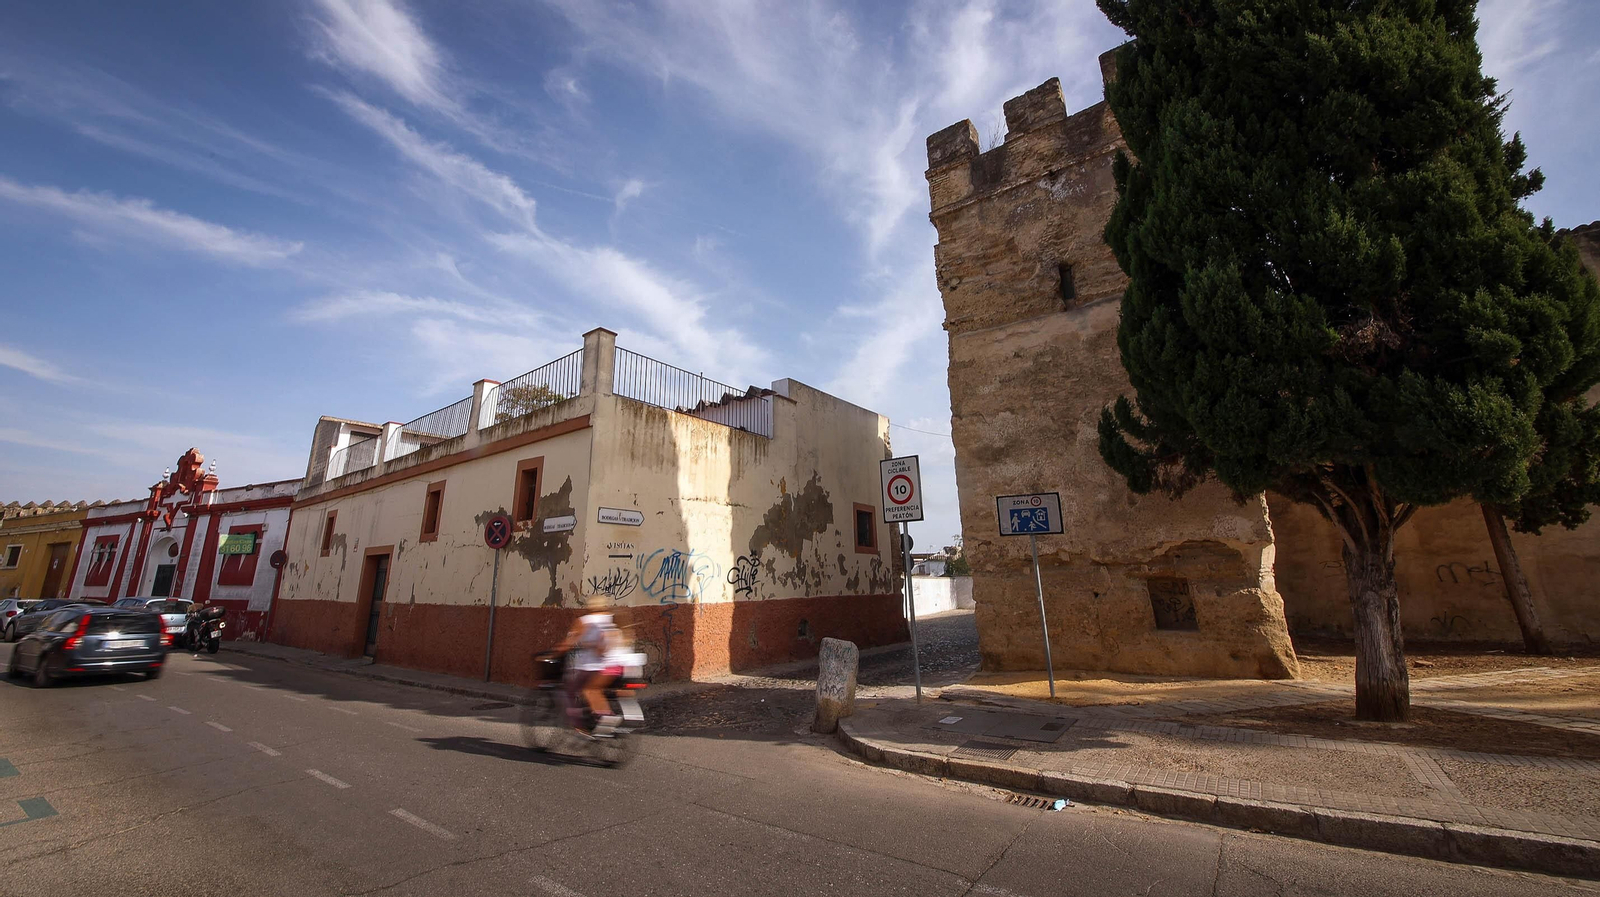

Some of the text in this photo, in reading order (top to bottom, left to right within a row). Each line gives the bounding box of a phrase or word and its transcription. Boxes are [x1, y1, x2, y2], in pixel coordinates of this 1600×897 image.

[891, 460, 906, 468] ZONA
[887, 466, 911, 474] CICLABLE
[894, 484, 907, 495] 10
[885, 504, 920, 513] PREFERENCIA
[892, 511, 914, 520] PEATÓN
